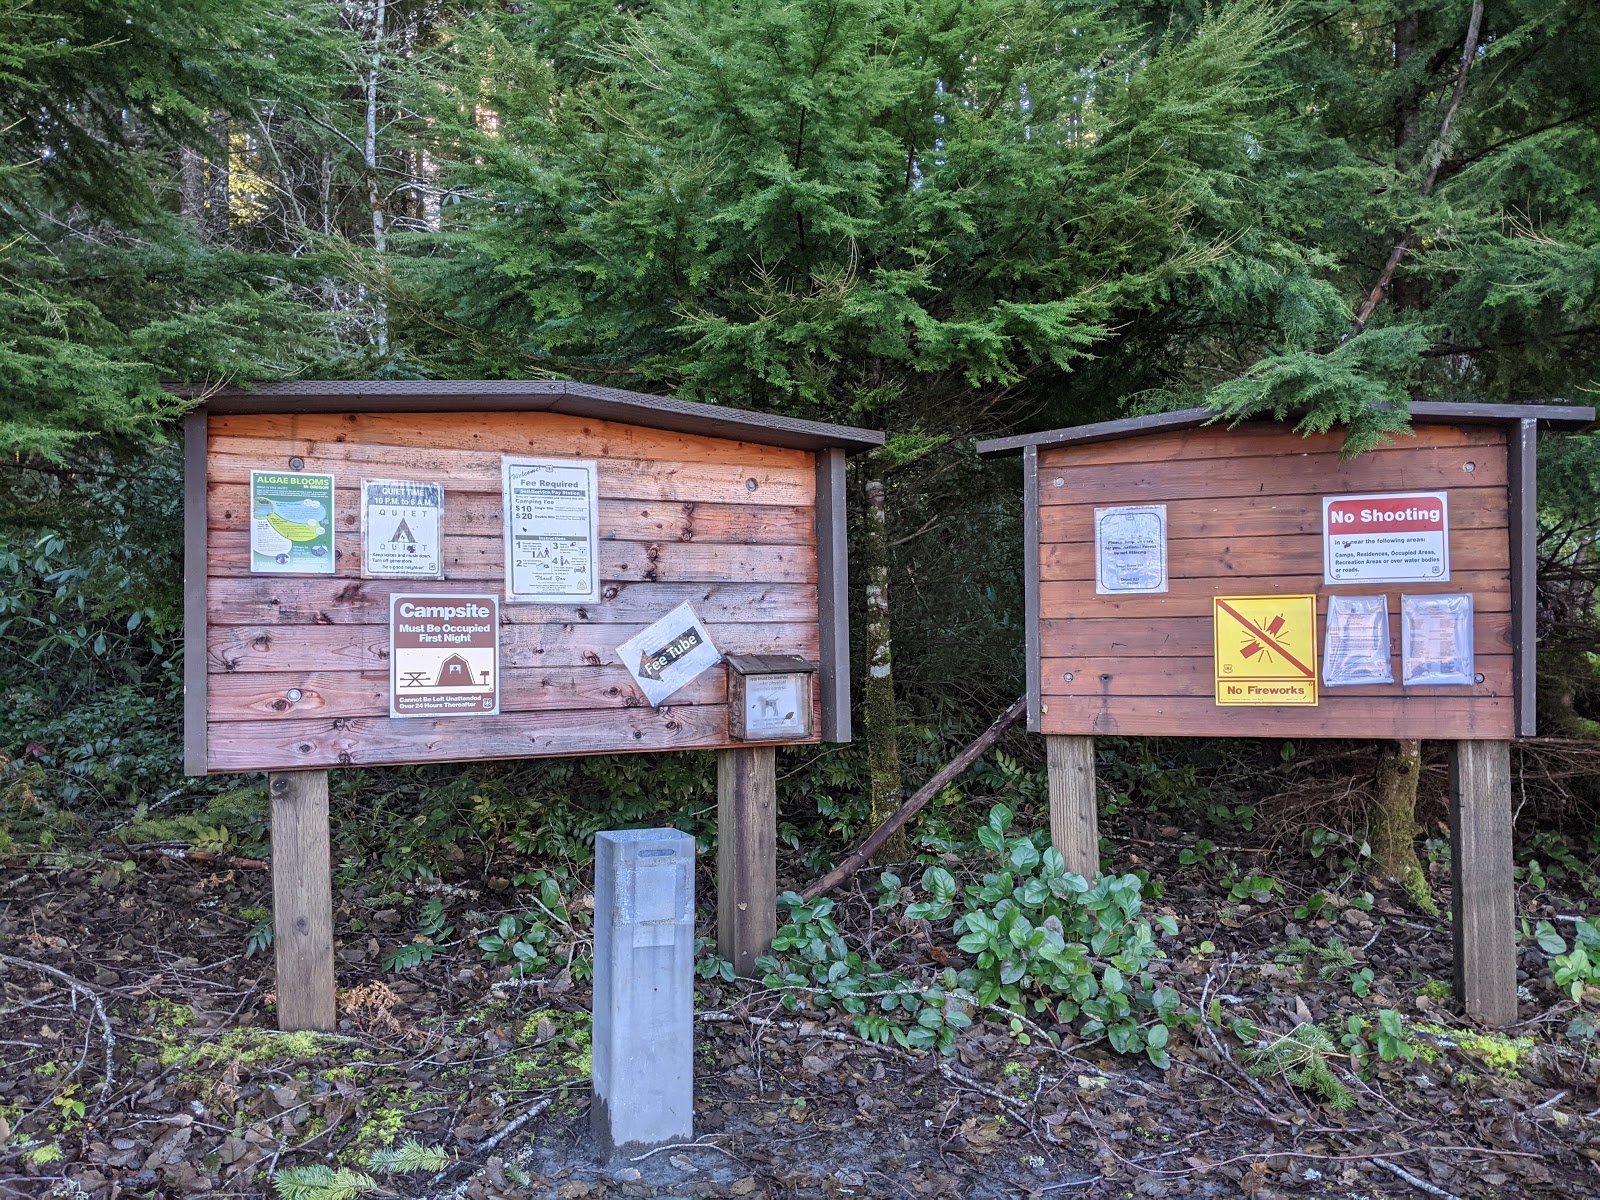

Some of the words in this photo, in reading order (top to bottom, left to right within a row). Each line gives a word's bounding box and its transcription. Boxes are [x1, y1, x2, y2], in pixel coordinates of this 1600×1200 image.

[256, 476, 289, 484] ALGAE
[290, 477, 329, 486] BLOOMS
[520, 479, 537, 487] Fee
[539, 480, 579, 488] Required
[382, 488, 405, 496] QUIET
[406, 488, 425, 496] TIME
[379, 509, 428, 517] QUIET
[1331, 510, 1355, 524] No
[1360, 507, 1440, 523] Shooting
[516, 541, 521, 549] 1
[1376, 537, 1405, 545] following
[552, 542, 558, 550] 3
[516, 559, 522, 567] 2
[399, 602, 490, 621] Campsite
[399, 624, 425, 633] Must
[427, 624, 441, 633] Be
[442, 624, 490, 634] Occupied
[419, 634, 442, 642] First
[444, 634, 471, 643] Night
[644, 656, 668, 675] Fee
[666, 635, 697, 659] Tube
[1227, 686, 1242, 695] No
[1247, 686, 1305, 695] Fireworks
